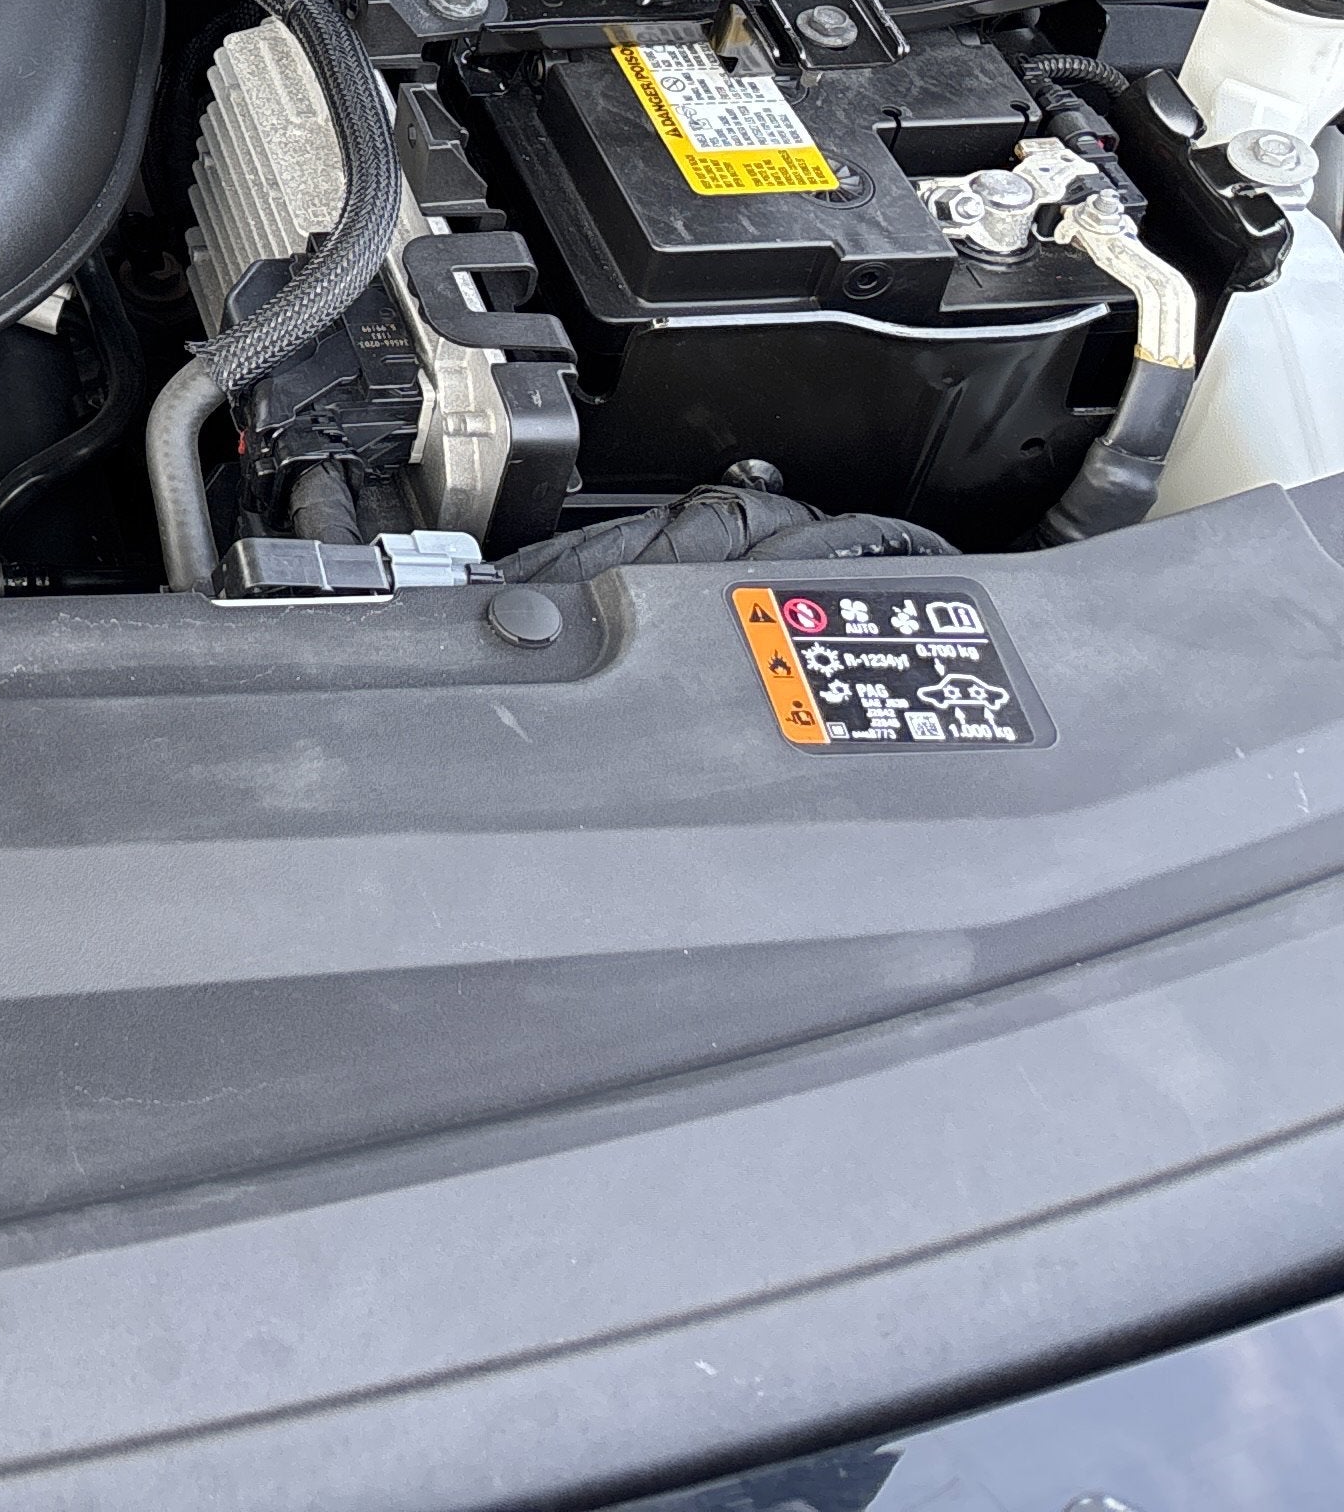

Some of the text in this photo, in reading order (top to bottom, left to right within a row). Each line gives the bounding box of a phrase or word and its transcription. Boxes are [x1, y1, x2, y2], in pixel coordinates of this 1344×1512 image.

[845, 622, 879, 634] AUTO
[915, 643, 979, 661] 0.700 kg
[855, 683, 890, 698] PAG
[948, 722, 1017, 741] 1.000 kg
